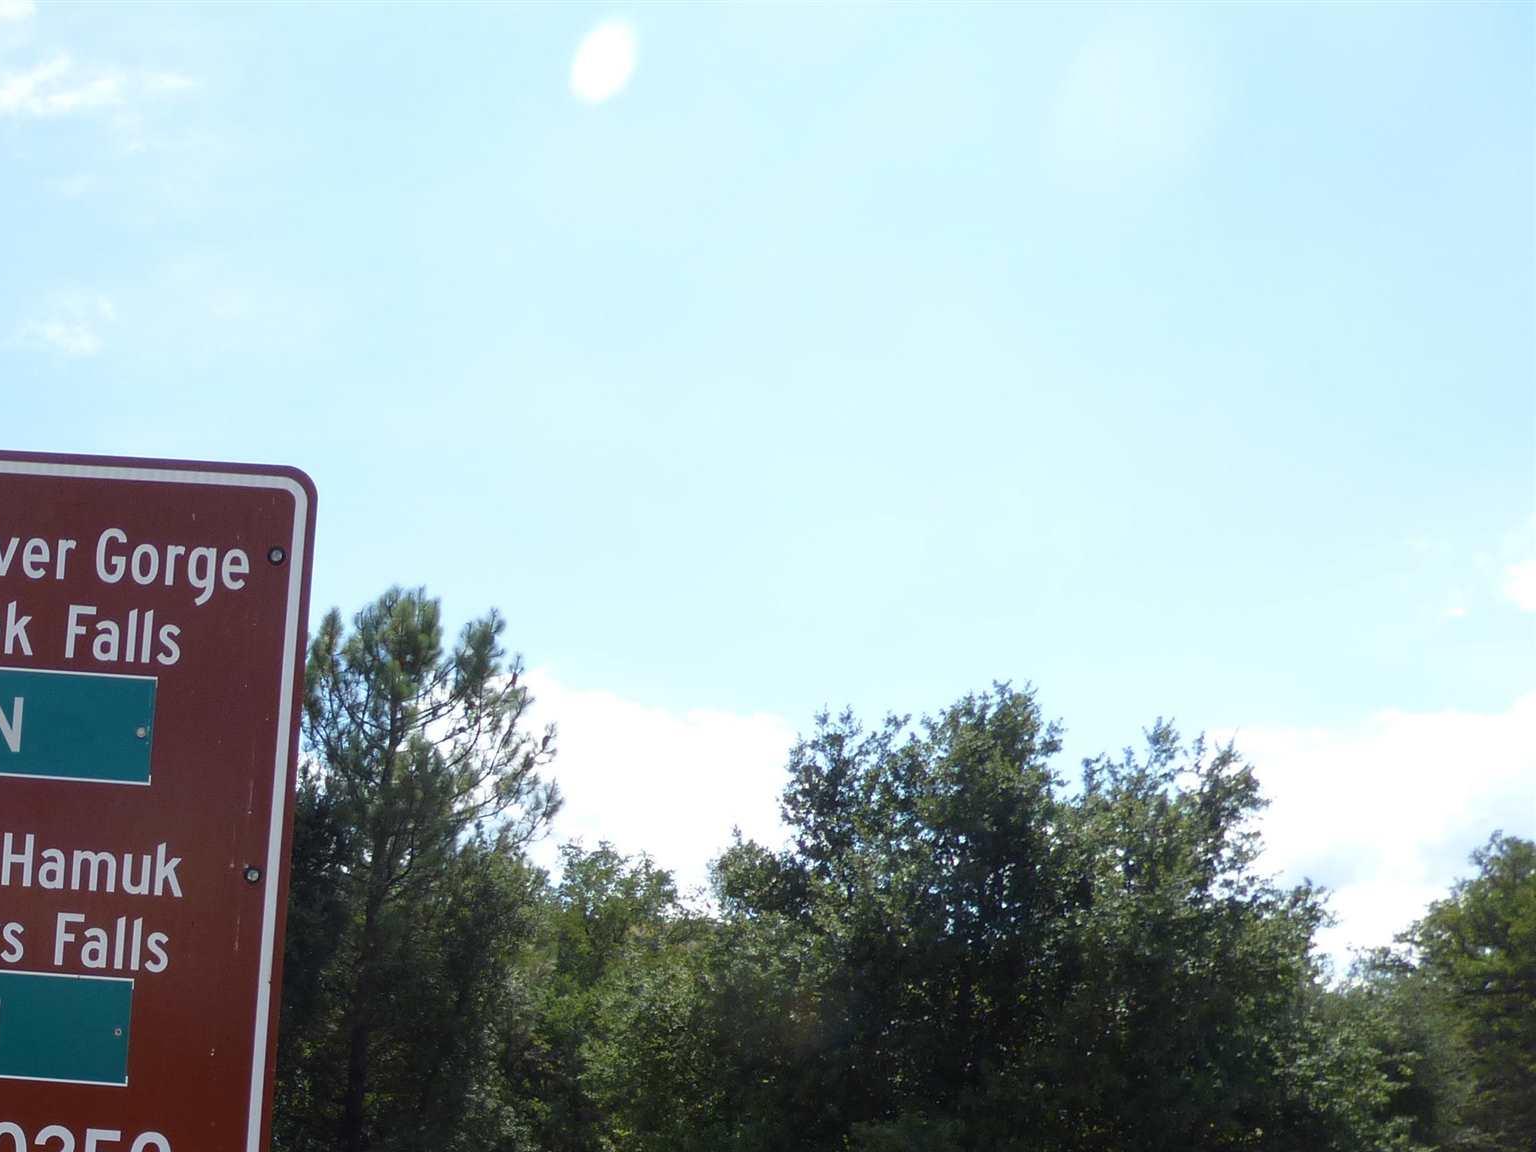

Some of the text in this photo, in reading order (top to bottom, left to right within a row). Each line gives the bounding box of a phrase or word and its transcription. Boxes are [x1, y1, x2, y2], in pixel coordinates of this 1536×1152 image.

[96, 528, 250, 606] Gorge
[65, 604, 181, 665] Falls
[1, 832, 183, 898] Hamuk
[54, 912, 169, 973] Falls
